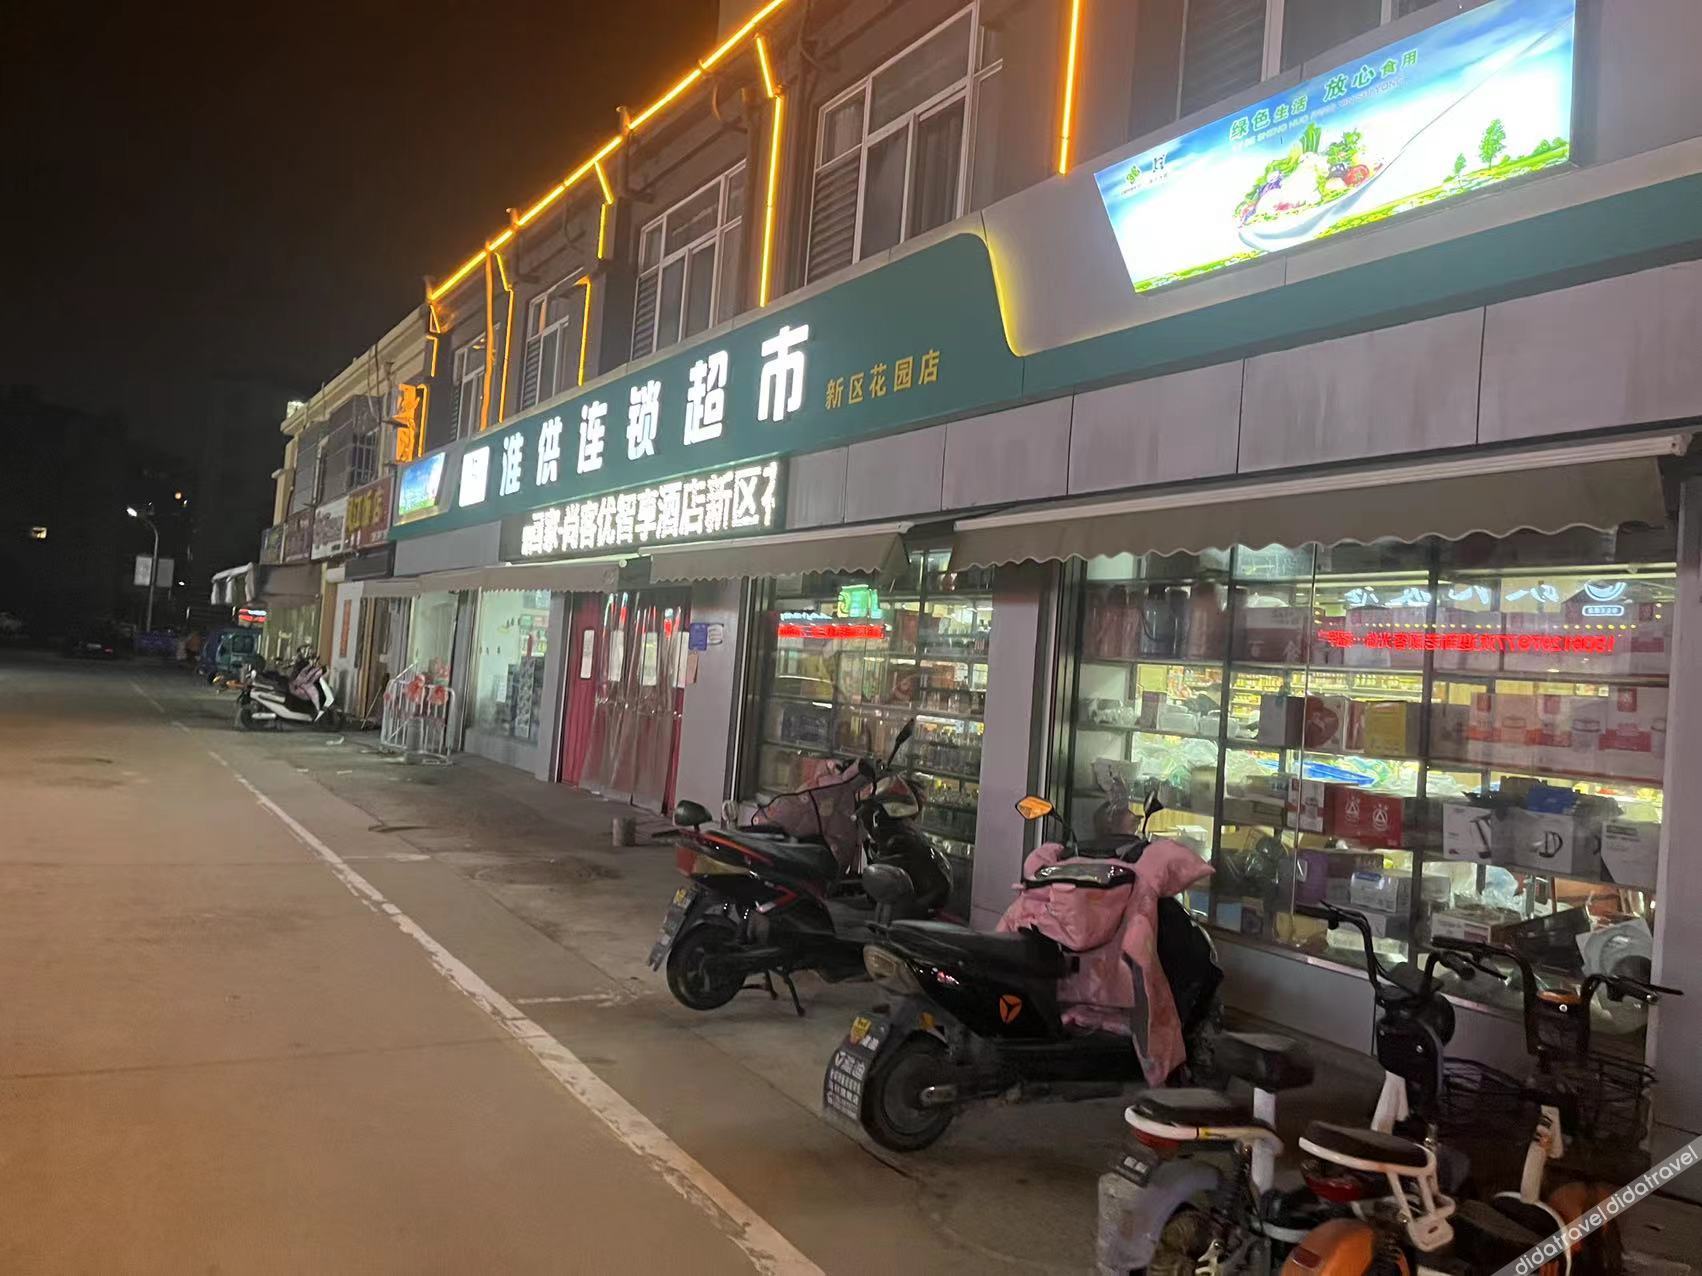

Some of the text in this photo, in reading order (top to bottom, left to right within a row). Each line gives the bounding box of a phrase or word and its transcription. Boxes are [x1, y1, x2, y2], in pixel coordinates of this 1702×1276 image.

[1230, 96, 1307, 140] 绿色生活
[1323, 49, 1418, 102] 放心食用
[499, 324, 809, 497] 淮供连锁超市
[825, 348, 940, 410] 新区花园店
